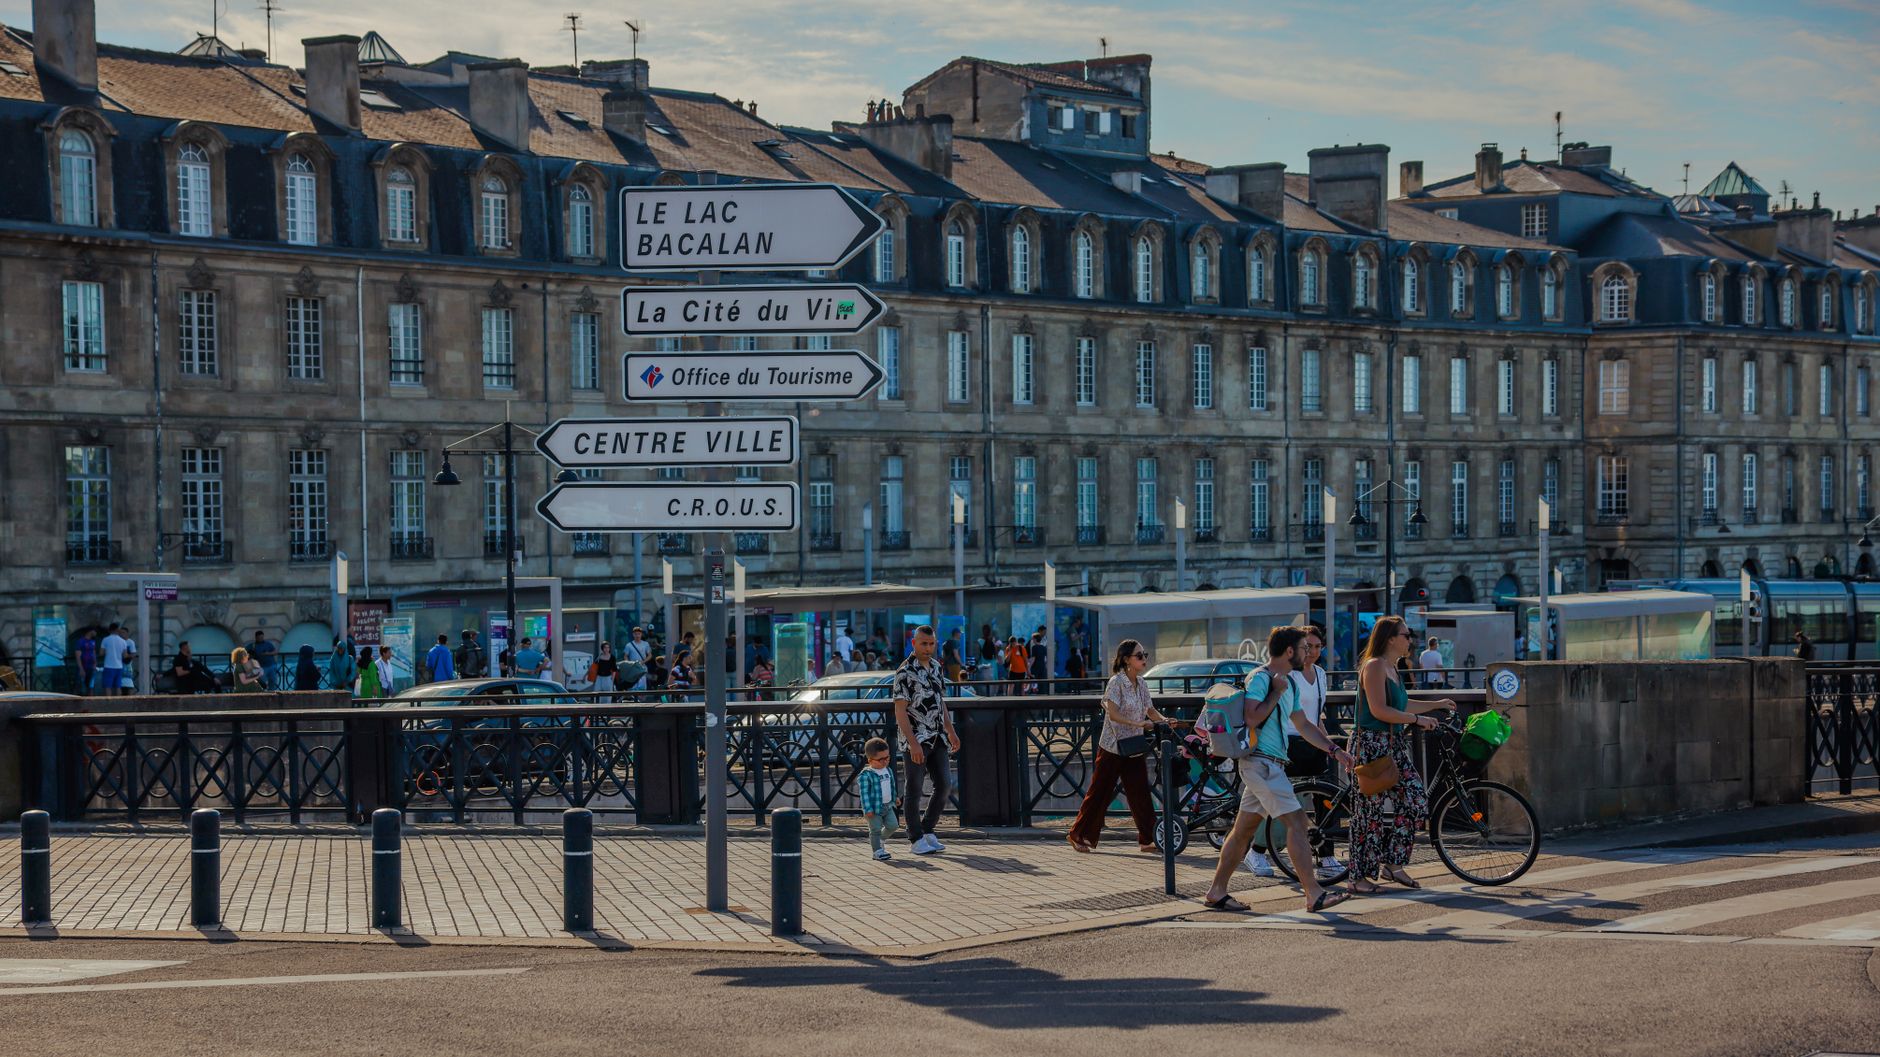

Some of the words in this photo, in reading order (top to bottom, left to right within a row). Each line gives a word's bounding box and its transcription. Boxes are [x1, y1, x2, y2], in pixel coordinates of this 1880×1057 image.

[636, 202, 667, 225] LE
[684, 201, 738, 224] LAC
[637, 232, 773, 256] BACALAN
[637, 301, 666, 323] La
[682, 299, 740, 323] Cité
[757, 299, 788, 322] du
[671, 368, 730, 386] Office
[737, 367, 760, 385] du
[768, 366, 853, 385] Tourisme
[574, 431, 686, 455] CENTRE
[707, 430, 783, 452] VILLE
[667, 498, 783, 516] C.R.O.U.S.
